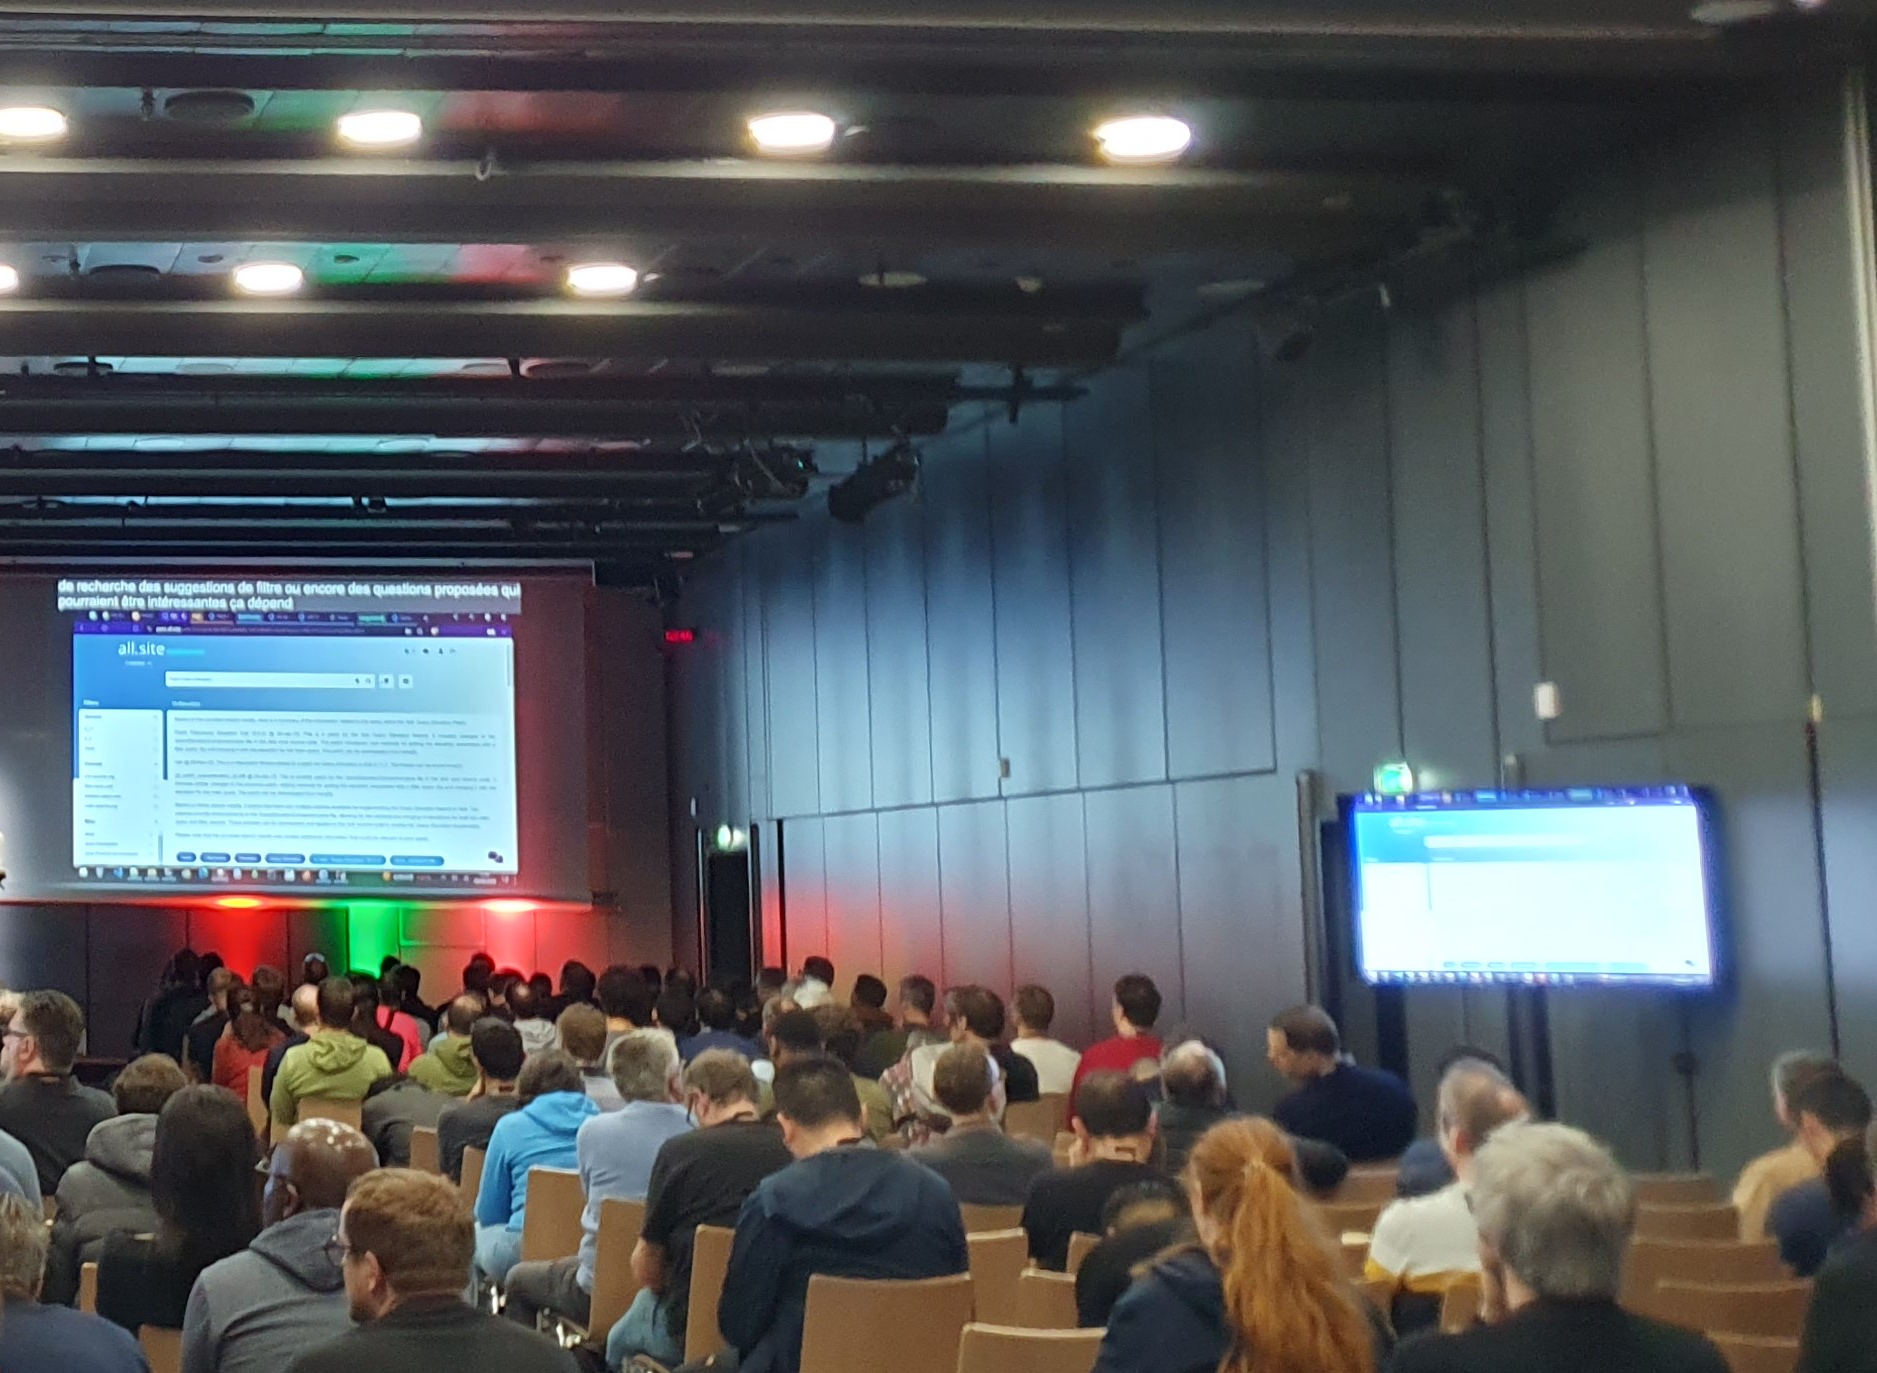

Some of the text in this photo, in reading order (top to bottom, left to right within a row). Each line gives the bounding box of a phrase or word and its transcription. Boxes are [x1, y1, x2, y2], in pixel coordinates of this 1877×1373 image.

[58, 580, 521, 599] de recherche des suggestions de filtre ou encore des questions proposées qui
[58, 596, 119, 612] pourraient
[122, 596, 145, 609] être
[148, 596, 227, 609] intéressantes
[248, 596, 293, 612] dépend
[118, 641, 166, 656] all.site
